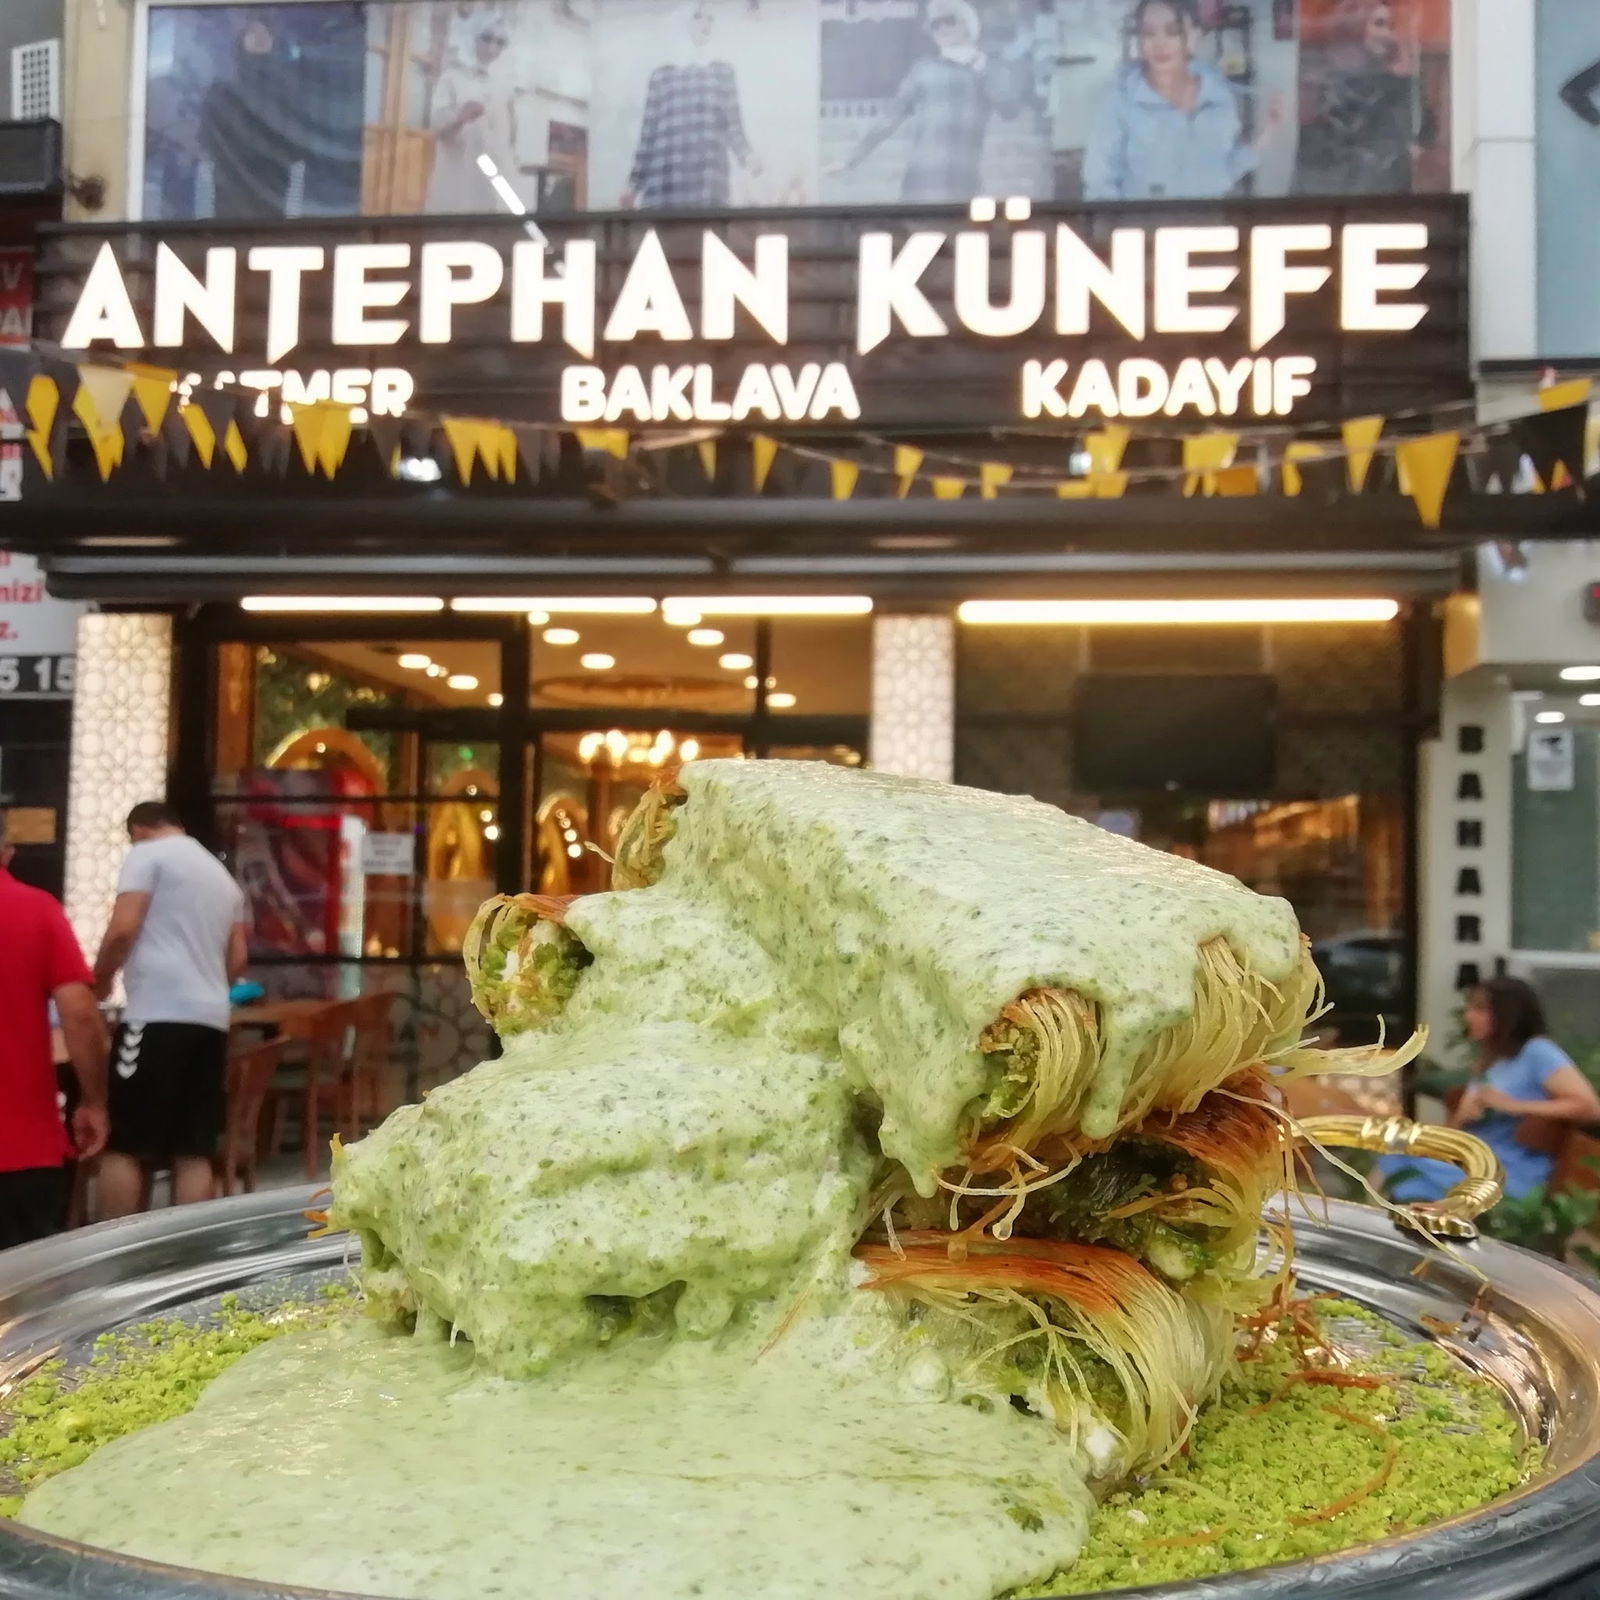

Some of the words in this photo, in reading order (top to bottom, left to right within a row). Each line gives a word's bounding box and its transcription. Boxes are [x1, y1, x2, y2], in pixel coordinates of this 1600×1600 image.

[61, 229, 789, 363] ANTEPHAN
[857, 196, 1429, 355] KÜNEFE
[168, 369, 413, 425] TMER
[561, 362, 861, 422] BAKLAVA
[1022, 356, 1317, 419] KADAYIF
